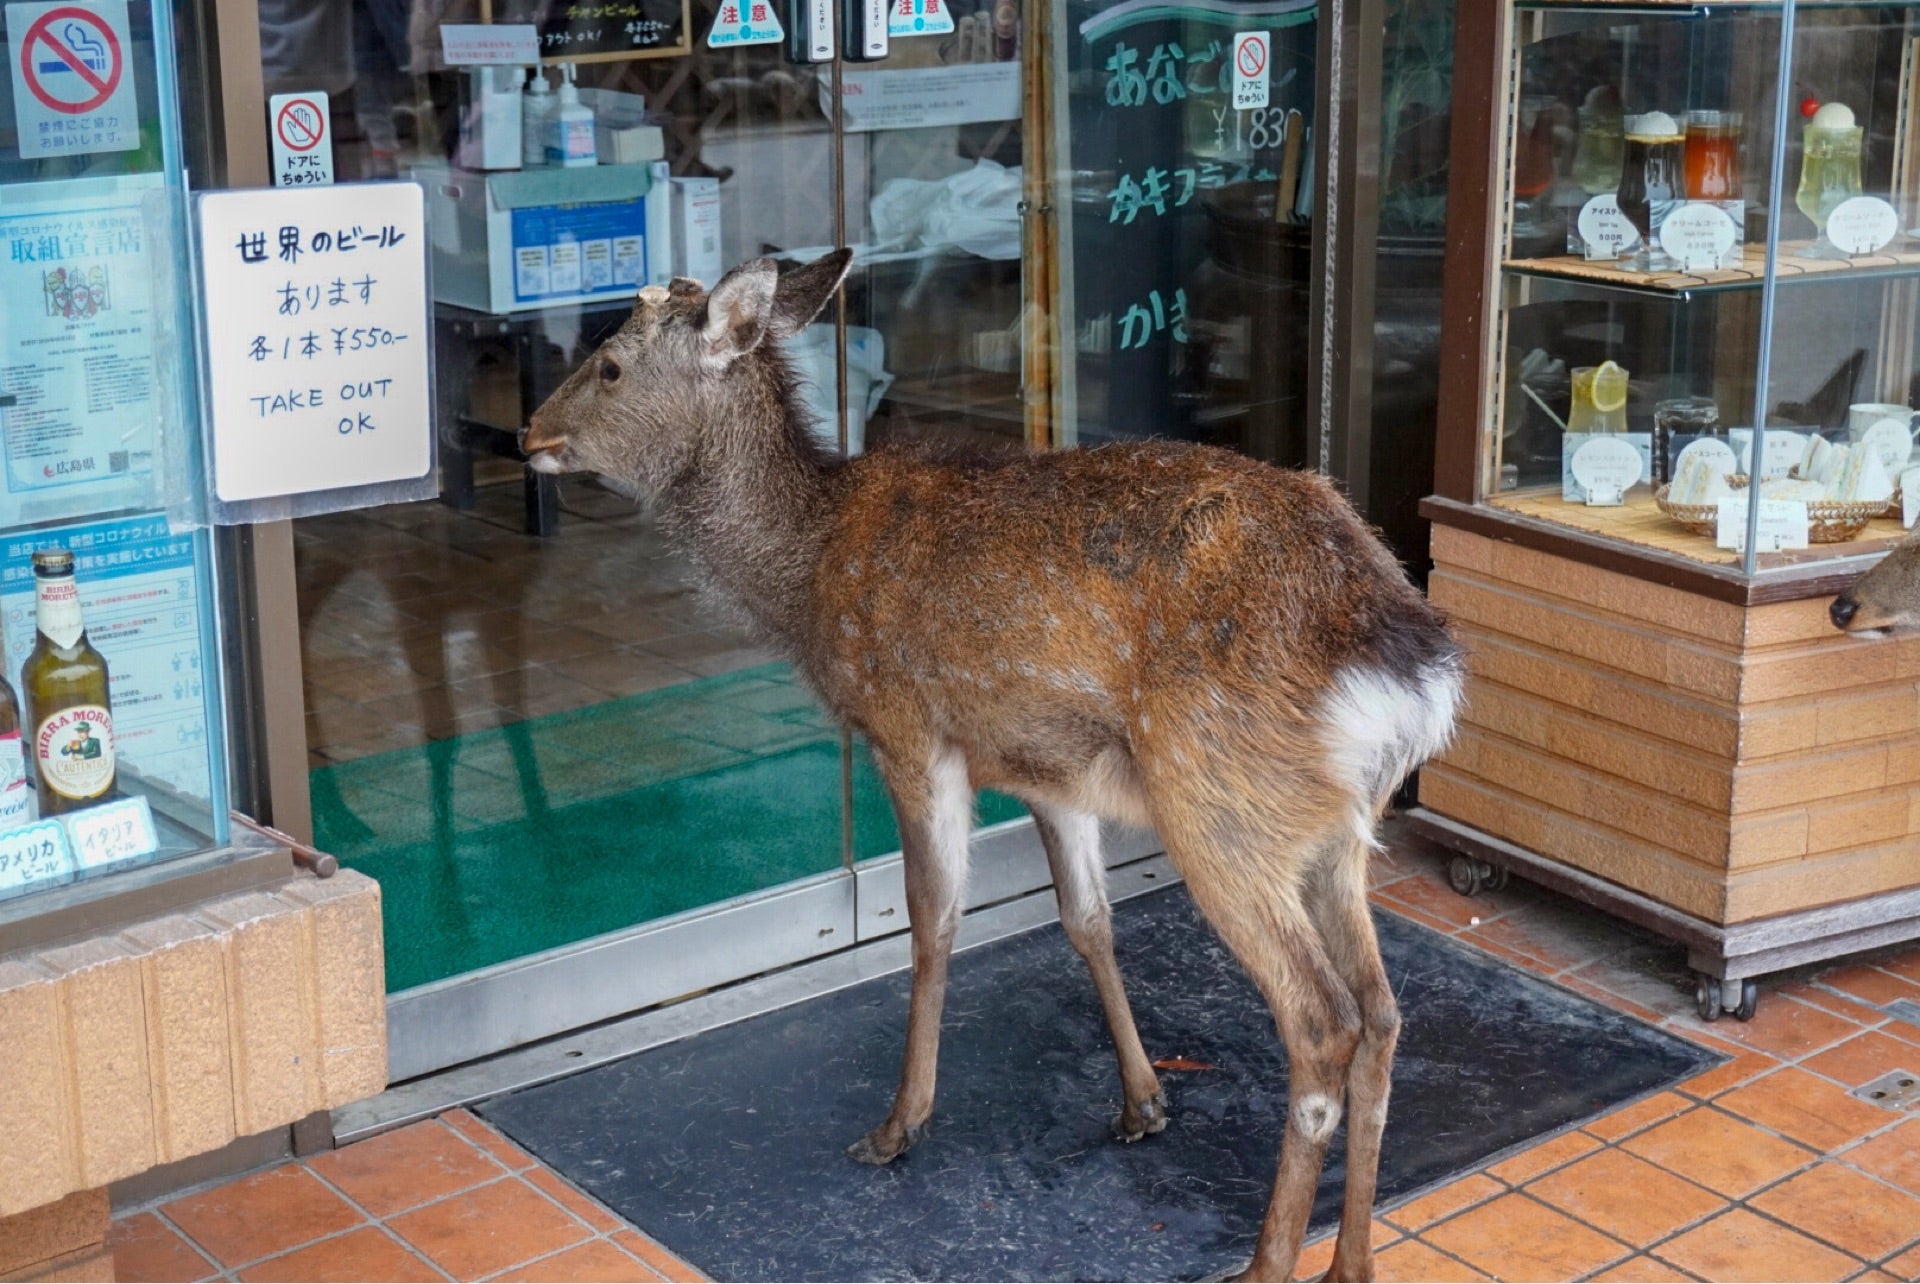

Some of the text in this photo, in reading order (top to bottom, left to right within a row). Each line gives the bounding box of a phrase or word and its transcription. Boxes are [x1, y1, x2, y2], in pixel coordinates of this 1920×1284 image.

[1237, 93, 1265, 104] ちゅうい
[1241, 80, 1262, 91] ドアに
[287, 154, 321, 169] ドアに
[282, 170, 328, 186] ちゅうい
[11, 229, 141, 264] 取組宣言店
[235, 224, 406, 265] 世界のビール
[275, 273, 378, 317] あります
[249, 378, 393, 419] TAKE OUT
[337, 411, 376, 435] OK
[56, 456, 96, 475] 広島県
[8, 522, 168, 557] 当店では、新型コロナウイル
[39, 715, 71, 760] BIRRA
[85, 820, 134, 850] イタリア
[0, 839, 55, 873] アメリカ
[105, 842, 136, 858] ビール
[21, 860, 59, 880] ビール
